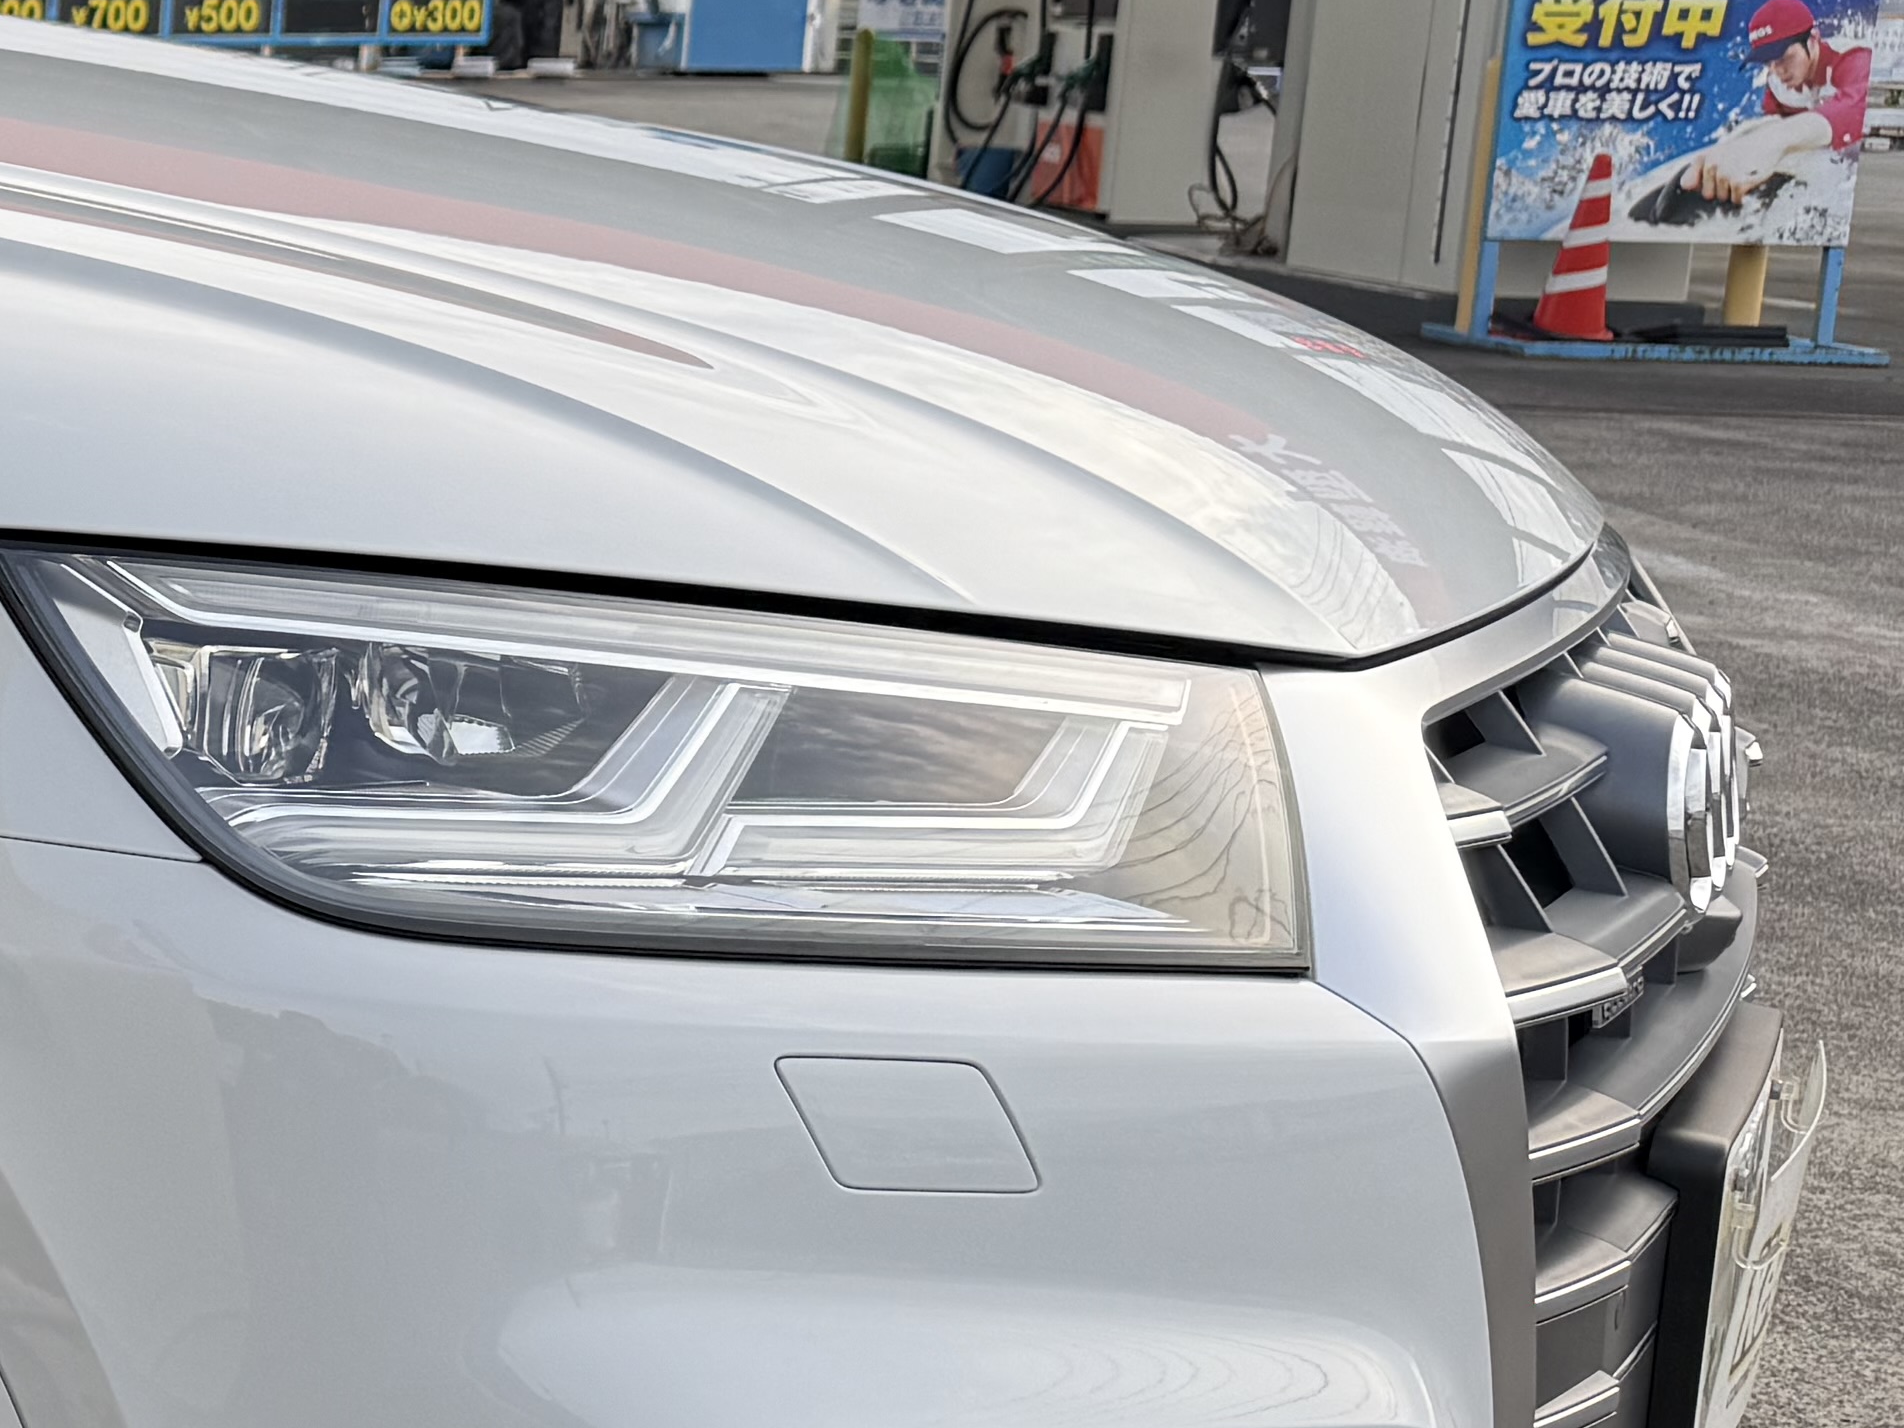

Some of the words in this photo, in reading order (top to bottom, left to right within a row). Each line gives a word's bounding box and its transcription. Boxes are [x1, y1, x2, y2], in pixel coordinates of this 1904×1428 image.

[1527, 59, 1703, 89] プロの技術で
